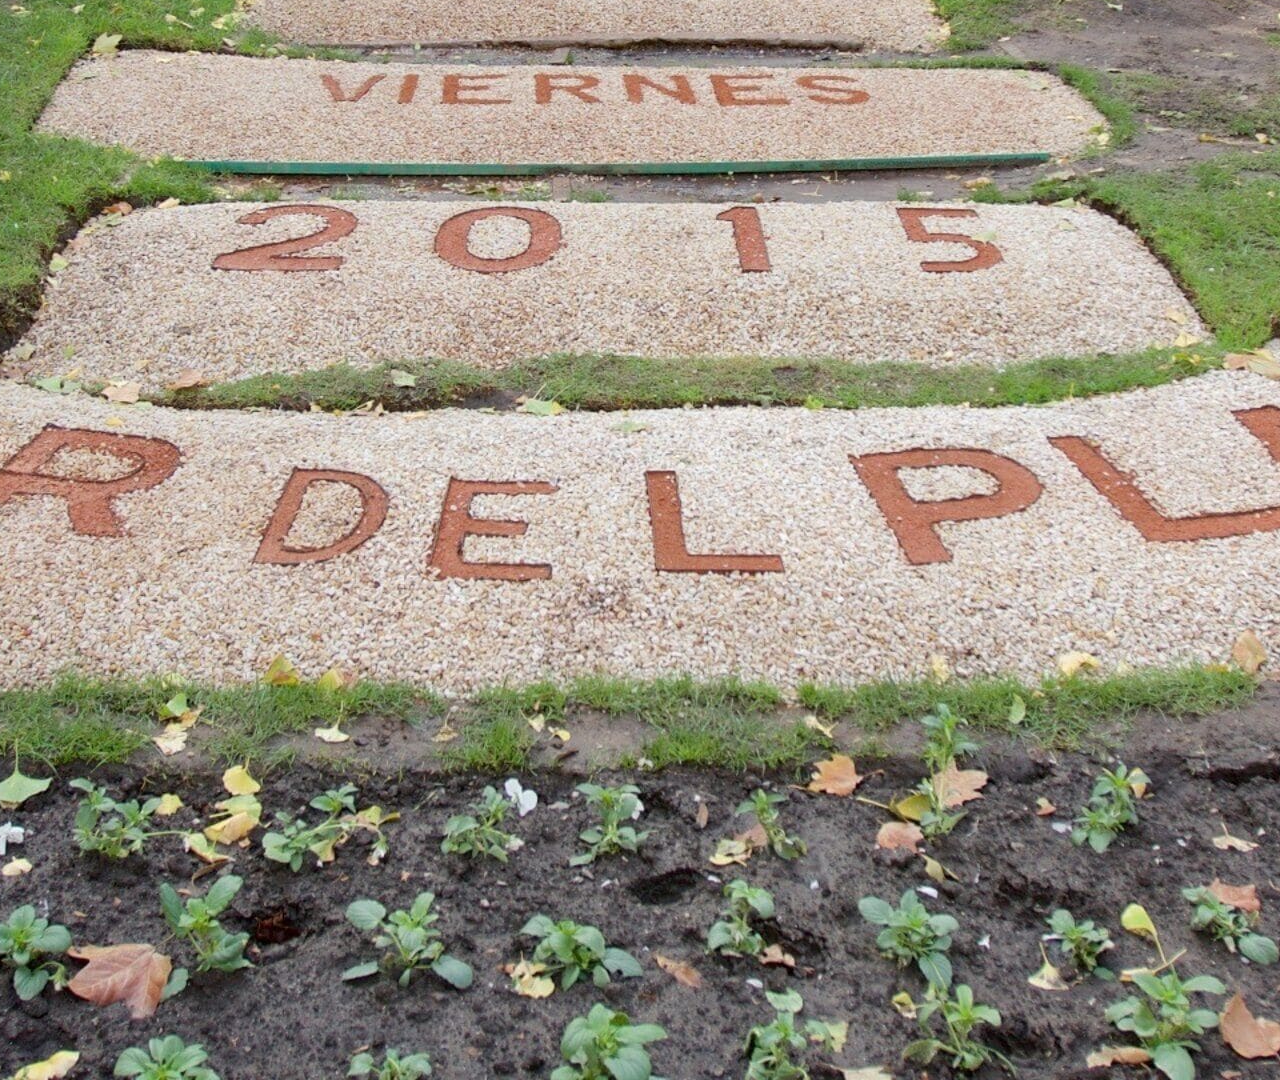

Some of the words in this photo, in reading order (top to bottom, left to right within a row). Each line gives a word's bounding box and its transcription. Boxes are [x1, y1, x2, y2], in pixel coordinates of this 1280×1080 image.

[321, 72, 872, 107] VIERNES
[210, 203, 1005, 273] 2015
[251, 467, 785, 581] DEL
